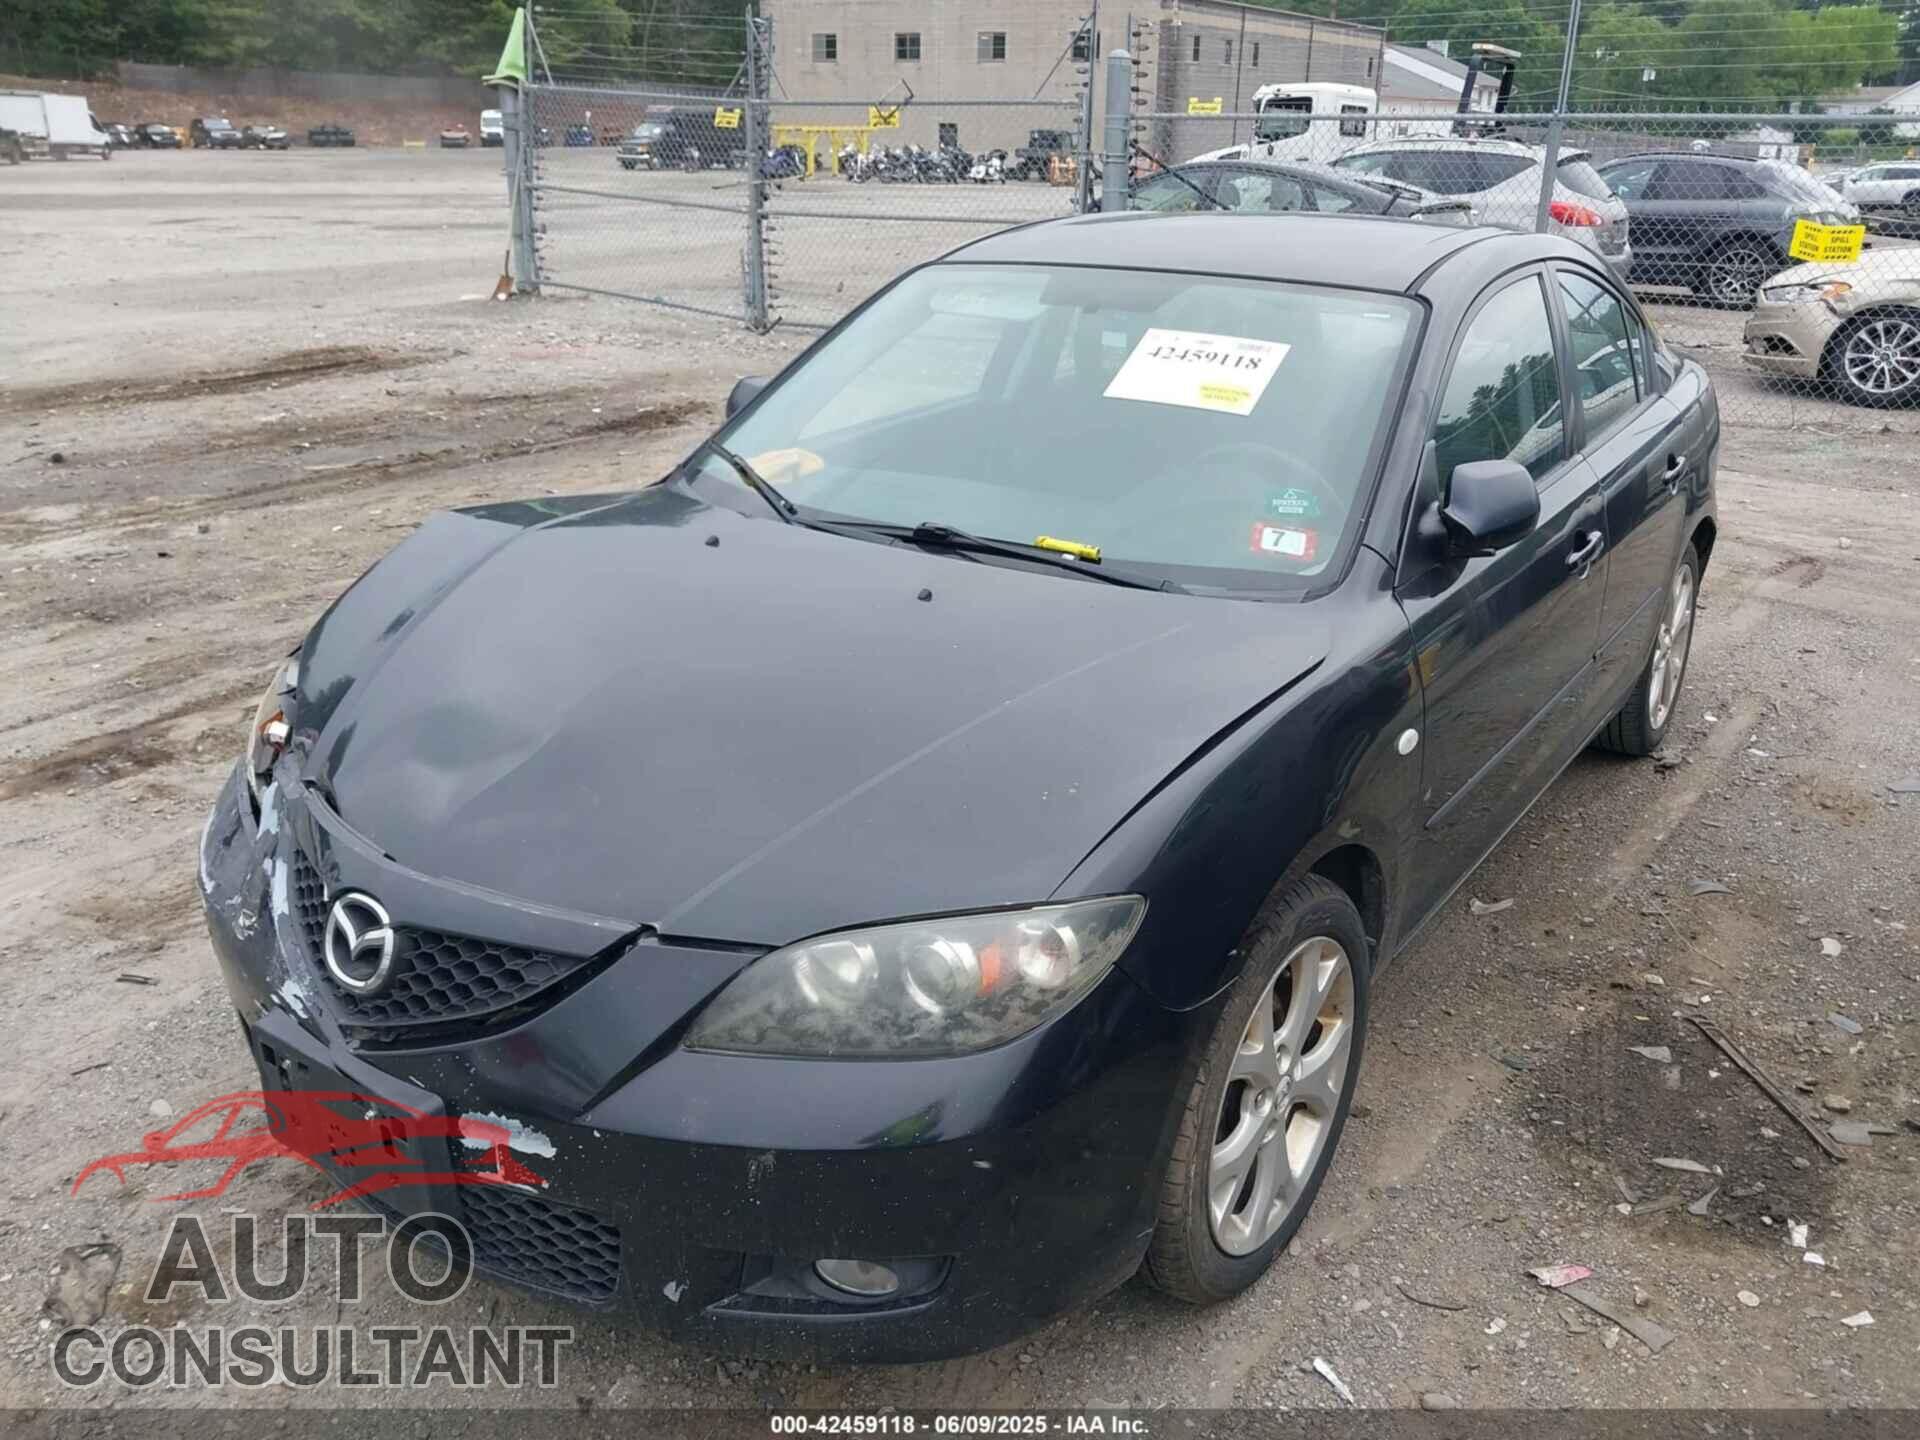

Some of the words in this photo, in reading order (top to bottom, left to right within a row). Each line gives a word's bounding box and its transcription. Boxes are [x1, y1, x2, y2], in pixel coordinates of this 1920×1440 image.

[1831, 236, 1849, 244] SPILL
[1823, 245, 1853, 254] STATION
[1147, 345, 1262, 370] 42459118
[1271, 530, 1286, 547] 7
